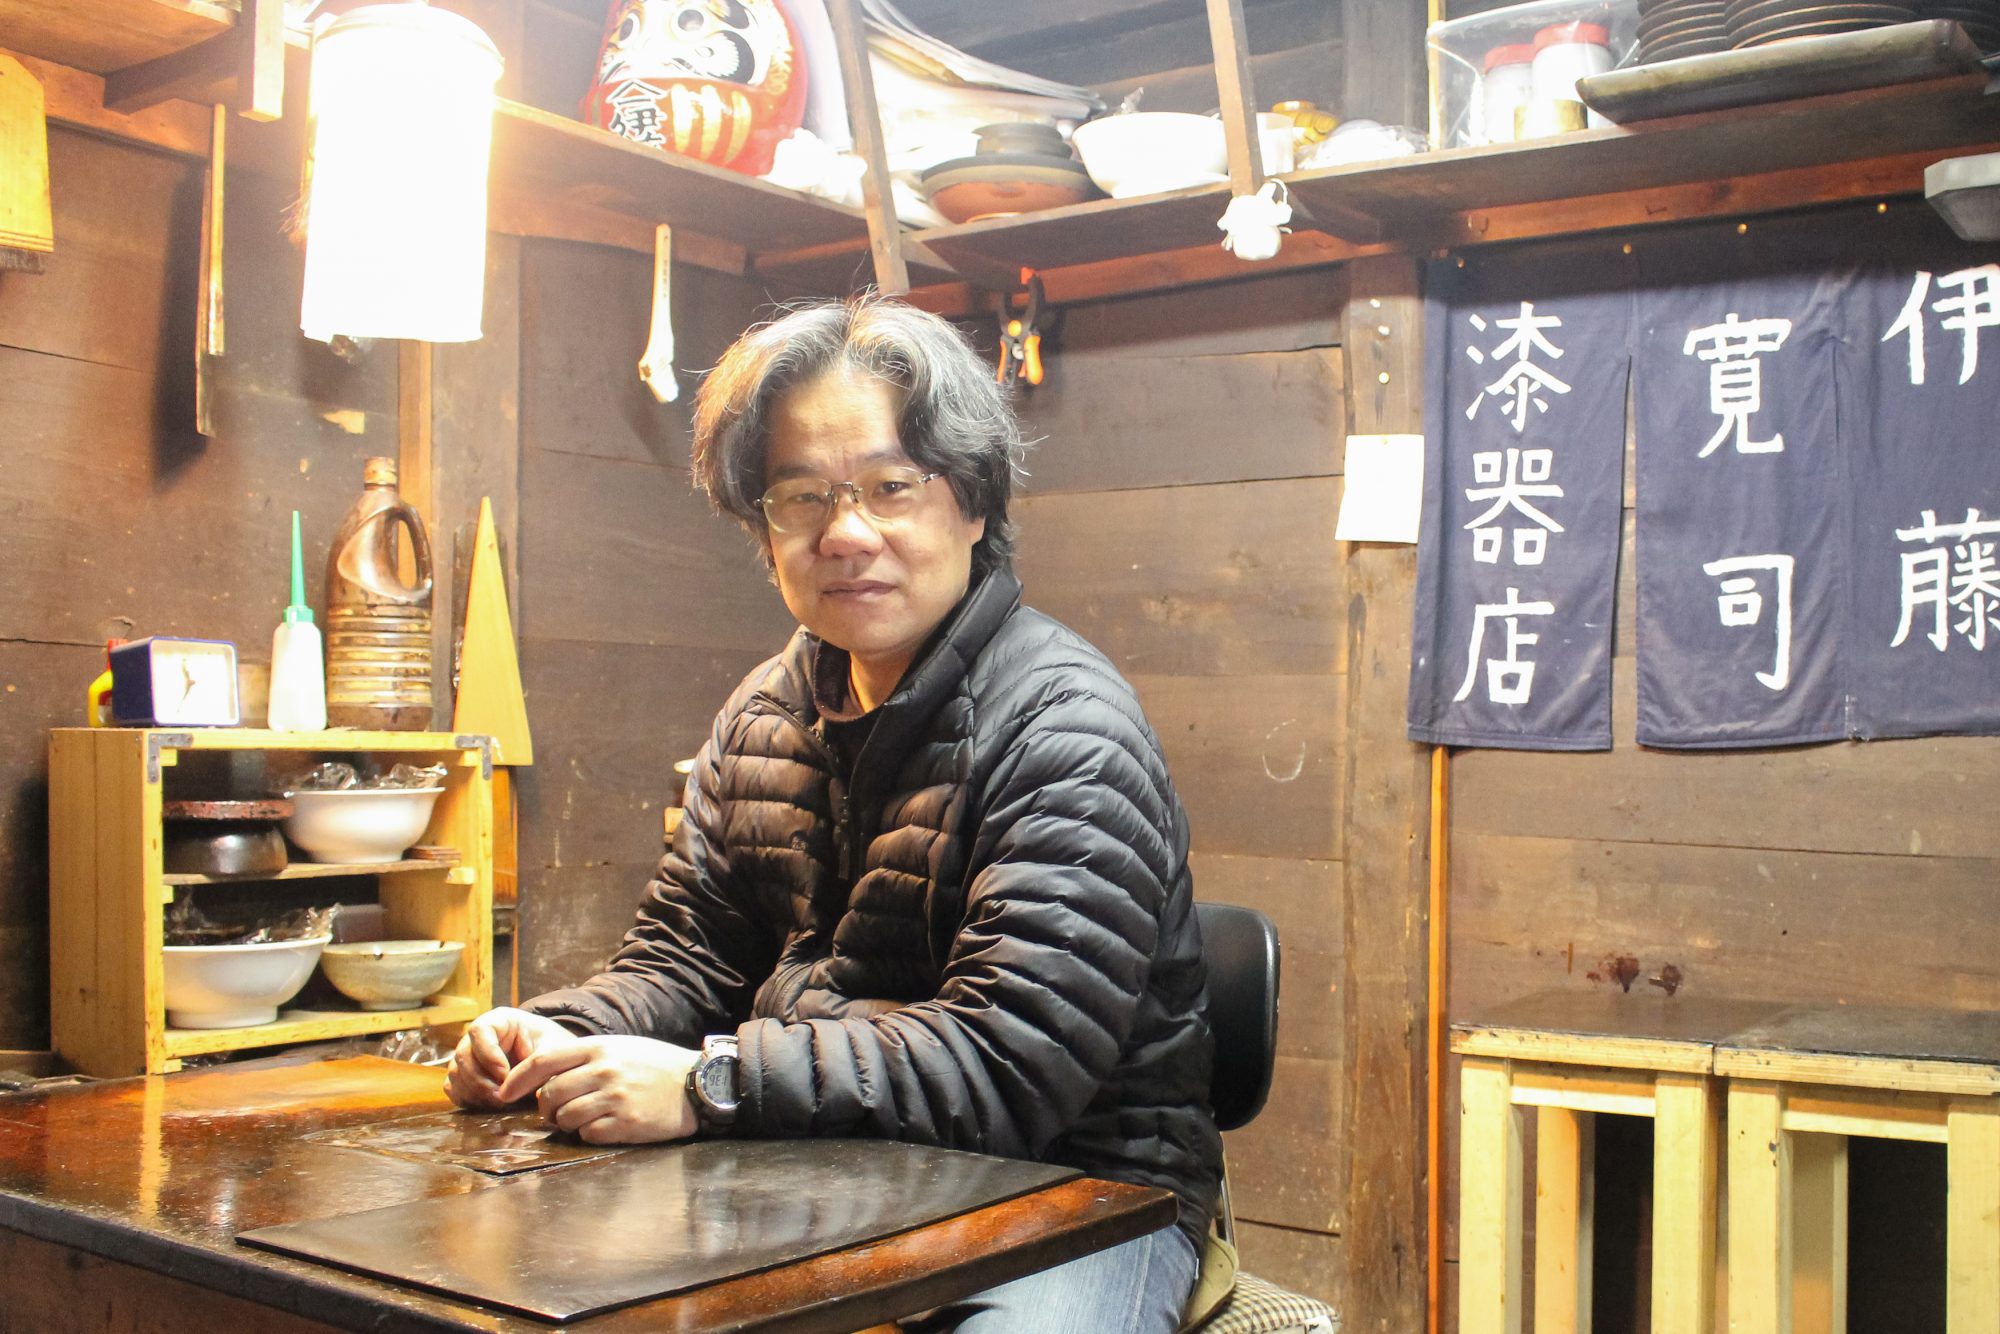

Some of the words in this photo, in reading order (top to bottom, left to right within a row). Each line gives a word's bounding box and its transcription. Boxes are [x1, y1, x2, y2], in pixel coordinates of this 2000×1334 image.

[1453, 302, 1572, 704] 漆器店
[1683, 313, 1794, 691] 寛司
[1881, 265, 2000, 652] 伊藤
